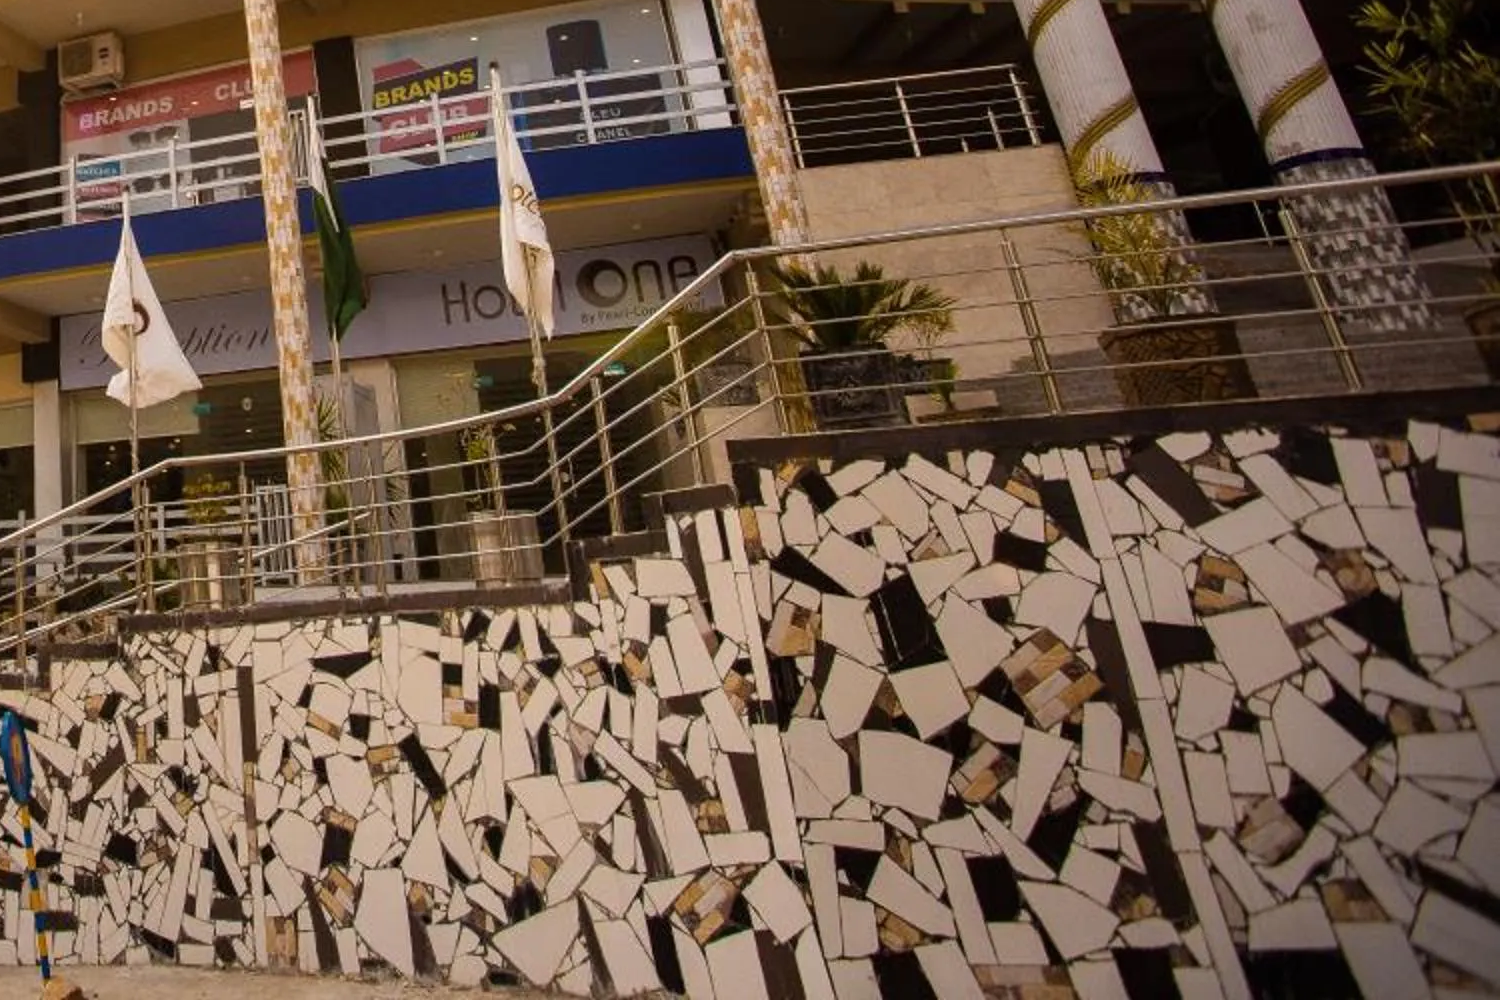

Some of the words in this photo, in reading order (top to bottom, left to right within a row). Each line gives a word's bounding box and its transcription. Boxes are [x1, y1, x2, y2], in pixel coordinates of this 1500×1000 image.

[373, 67, 476, 109] BRANDS
[78, 96, 174, 131] BRANDS
[575, 126, 631, 143] CANEL
